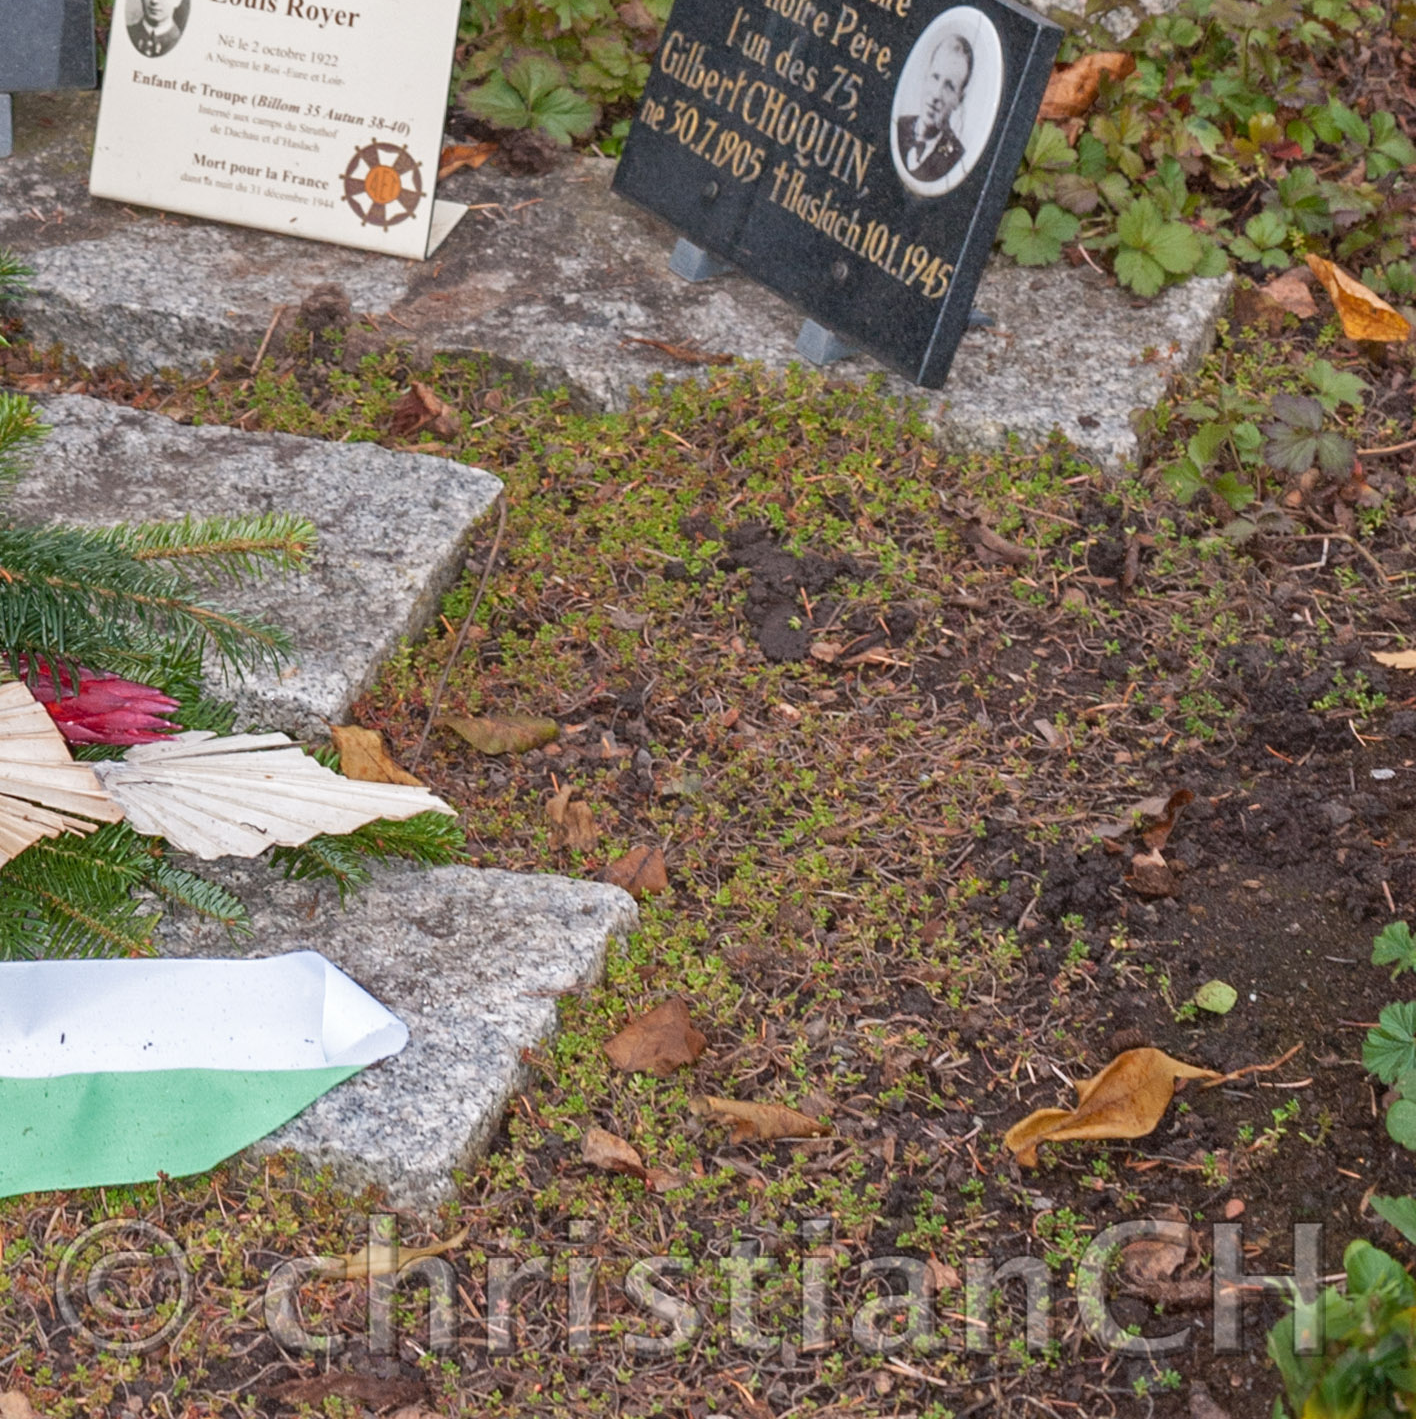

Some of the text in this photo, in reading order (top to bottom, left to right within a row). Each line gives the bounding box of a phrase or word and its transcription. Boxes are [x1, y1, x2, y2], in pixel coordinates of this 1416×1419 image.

[215, 53, 250, 72] Nogent
[217, 33, 340, 68] Né le 2 octobre 1922
[829, 3, 893, 81] Père,
[131, 69, 411, 138] Enfant de Troupe (Billom 35 Autun 38-40)
[774, 36, 820, 93] des
[821, 63, 864, 122] 75,
[639, 95, 669, 133] né
[659, 29, 877, 200] Gilbert CHOQUIN,
[191, 152, 329, 191] Mort pour la France
